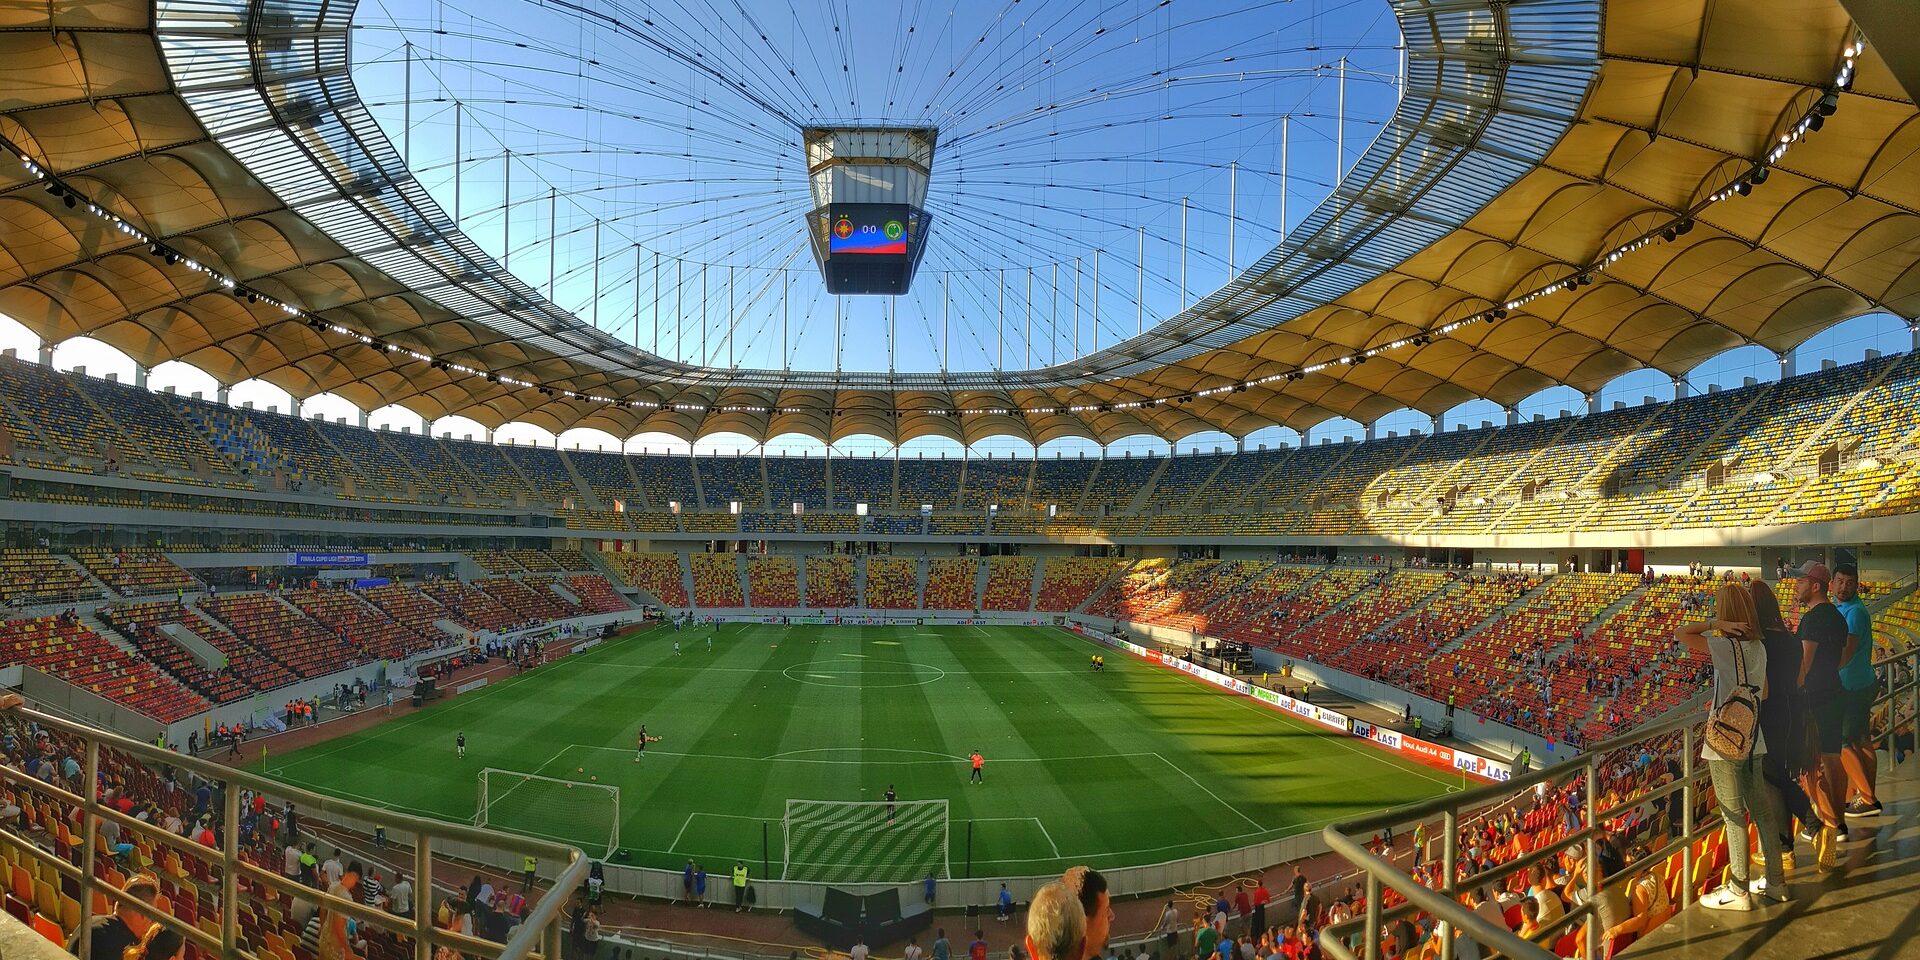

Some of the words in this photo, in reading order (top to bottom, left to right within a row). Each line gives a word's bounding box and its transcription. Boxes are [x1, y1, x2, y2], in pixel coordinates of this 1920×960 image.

[862, 225, 877, 234] 0:0
[1224, 678, 1248, 693] ADEPLAST
[1281, 698, 1311, 717] ADEPLAST
[1355, 724, 1397, 746] ADEPLAST
[1415, 744, 1428, 753] Audi
[1429, 748, 1438, 756] A4
[1457, 757, 1512, 781] ADEPLAS
